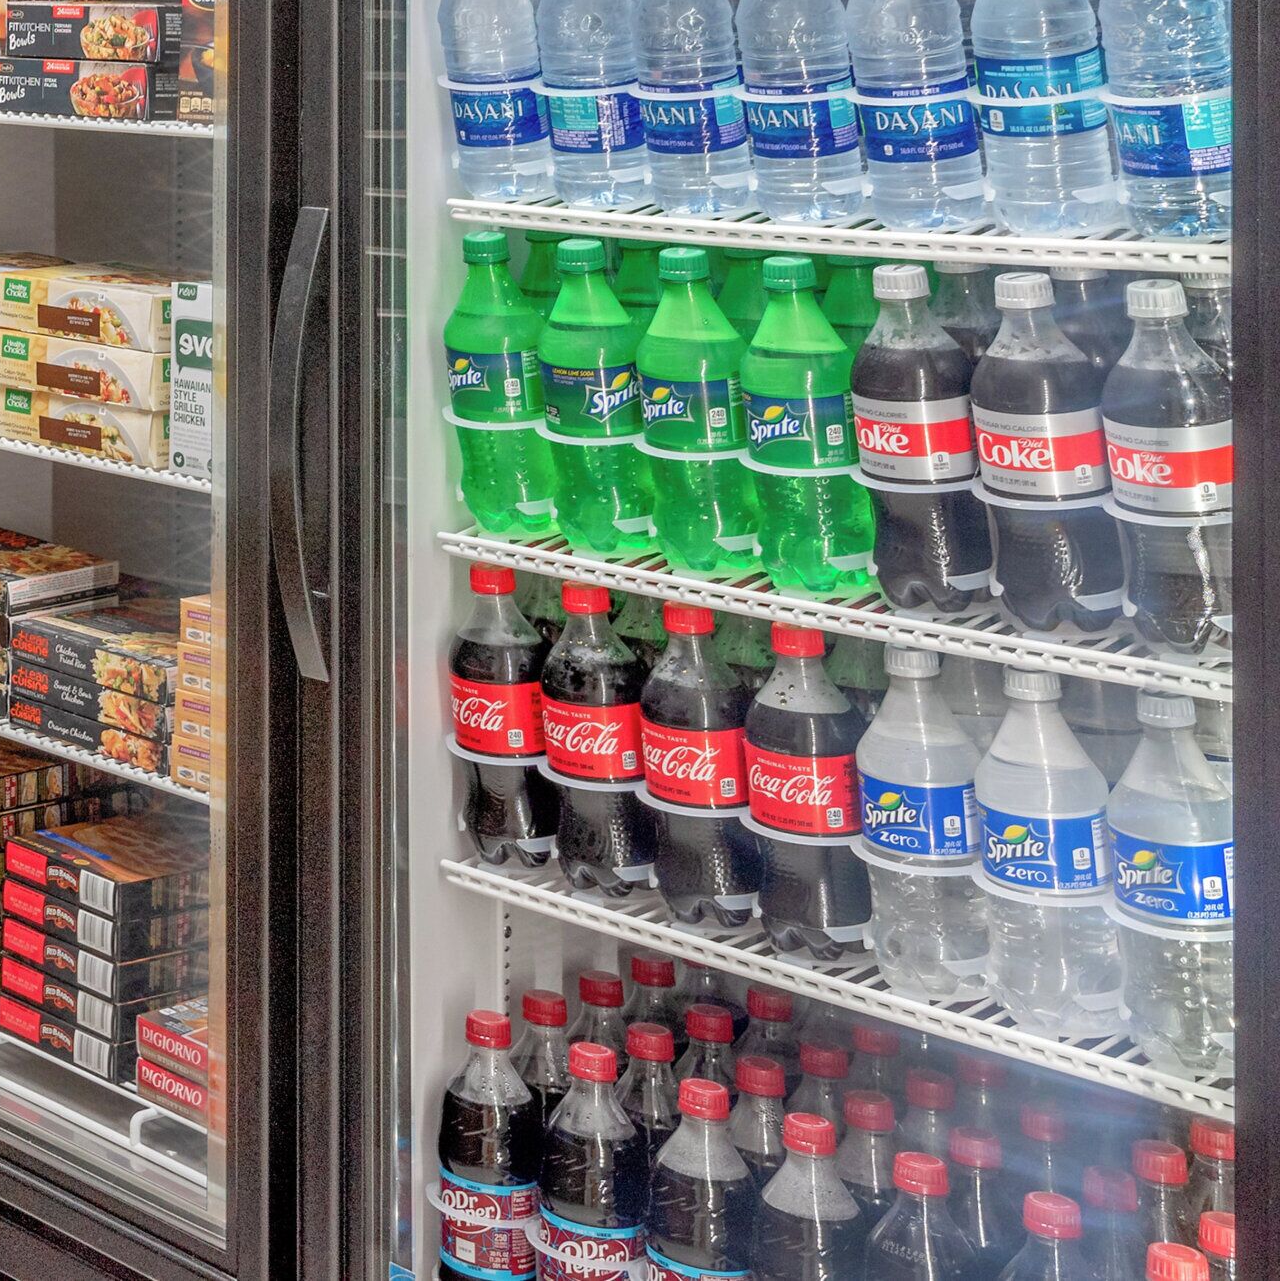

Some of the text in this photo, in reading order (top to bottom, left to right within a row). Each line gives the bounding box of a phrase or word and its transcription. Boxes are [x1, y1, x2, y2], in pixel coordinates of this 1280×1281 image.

[9, 31, 36, 51] Bowls
[1028, 64, 1044, 72] WATER
[454, 98, 524, 125] DASANI
[641, 101, 696, 127] ASANI
[748, 103, 811, 132] ASANI
[875, 104, 965, 136] DASANI
[5, 288, 28, 299] Choice
[8, 282, 28, 292] Healthy
[178, 285, 196, 300] new
[3, 345, 27, 356] Choice
[6, 339, 26, 350] Healthy
[447, 368, 482, 392] Sprite
[579, 369, 595, 377] SODA
[173, 378, 212, 394] HAWAIIAN
[506, 380, 520, 389] 240
[6, 398, 30, 410] Choice
[9, 392, 28, 403] Healthy
[173, 389, 197, 403] STYLE
[173, 400, 205, 416] GRILLED
[642, 398, 685, 424] Sprite
[711, 409, 725, 419] 240
[173, 412, 206, 427] CHICKEN
[750, 416, 801, 443] Sprite
[827, 426, 842, 436] 240
[855, 417, 910, 454] Coke
[879, 422, 901, 434] Diet
[979, 432, 1053, 470] Coke
[1018, 437, 1044, 449] Diet
[1107, 444, 1173, 485] Coke
[1140, 451, 1164, 463] Diet
[1081, 466, 1086, 476] 0
[1204, 484, 1210, 494] 0
[55, 643, 78, 659] Chicken
[59, 653, 86, 670] Fried Rice
[53, 679, 93, 700] Sweet & Sour
[462, 686, 479, 696] TASTE
[60, 692, 85, 707] Chicken
[452, 696, 509, 732] a-Cola
[571, 711, 592, 720] TASTE
[47, 719, 94, 743] Orange Chicken
[509, 731, 522, 740] 240
[667, 734, 688, 744] TASTE
[623, 751, 636, 761] 240
[756, 756, 811, 773] ORIGINAL TASTE
[721, 779, 735, 790] 240
[749, 763, 837, 808] Coca-Cola
[827, 808, 842, 819] 240
[865, 803, 917, 829] Sprite
[949, 818, 955, 828] 0
[879, 831, 916, 848] zero
[987, 837, 1044, 864] Sprite
[1079, 849, 1085, 859] 0
[48, 868, 78, 887] RED BARON
[1005, 865, 1047, 883] zero
[1118, 861, 1173, 890] Sprite
[1209, 879, 1215, 890] 0
[1135, 892, 1175, 911] zero
[46, 907, 75, 926] RED BARON
[46, 946, 75, 966] RED BARON
[455, 1190, 479, 1209] Dr
[493, 1233, 508, 1242] 250
[581, 1240, 609, 1259] Dr
[650, 1263, 667, 1281] Dr
